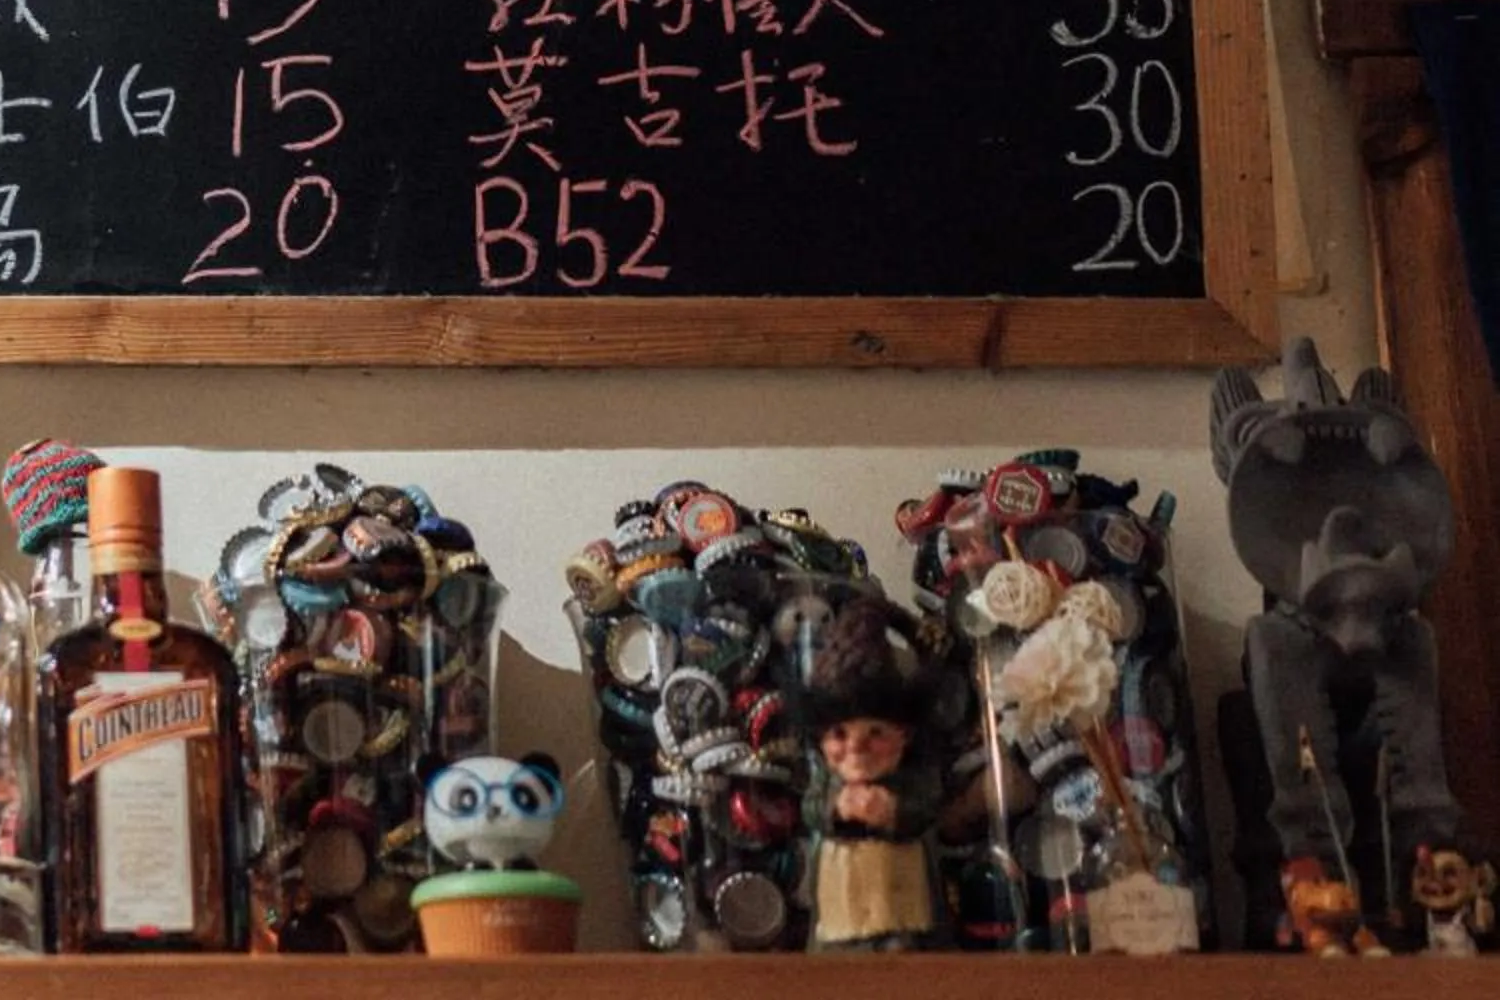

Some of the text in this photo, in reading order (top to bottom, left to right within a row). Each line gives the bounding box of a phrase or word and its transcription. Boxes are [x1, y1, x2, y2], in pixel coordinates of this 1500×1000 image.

[232, 54, 344, 157] 15
[464, 37, 1180, 171] 莫吉托 30
[181, 159, 339, 284] 20
[475, 176, 1182, 286] B52 20
[77, 690, 203, 762] COINTREAU
